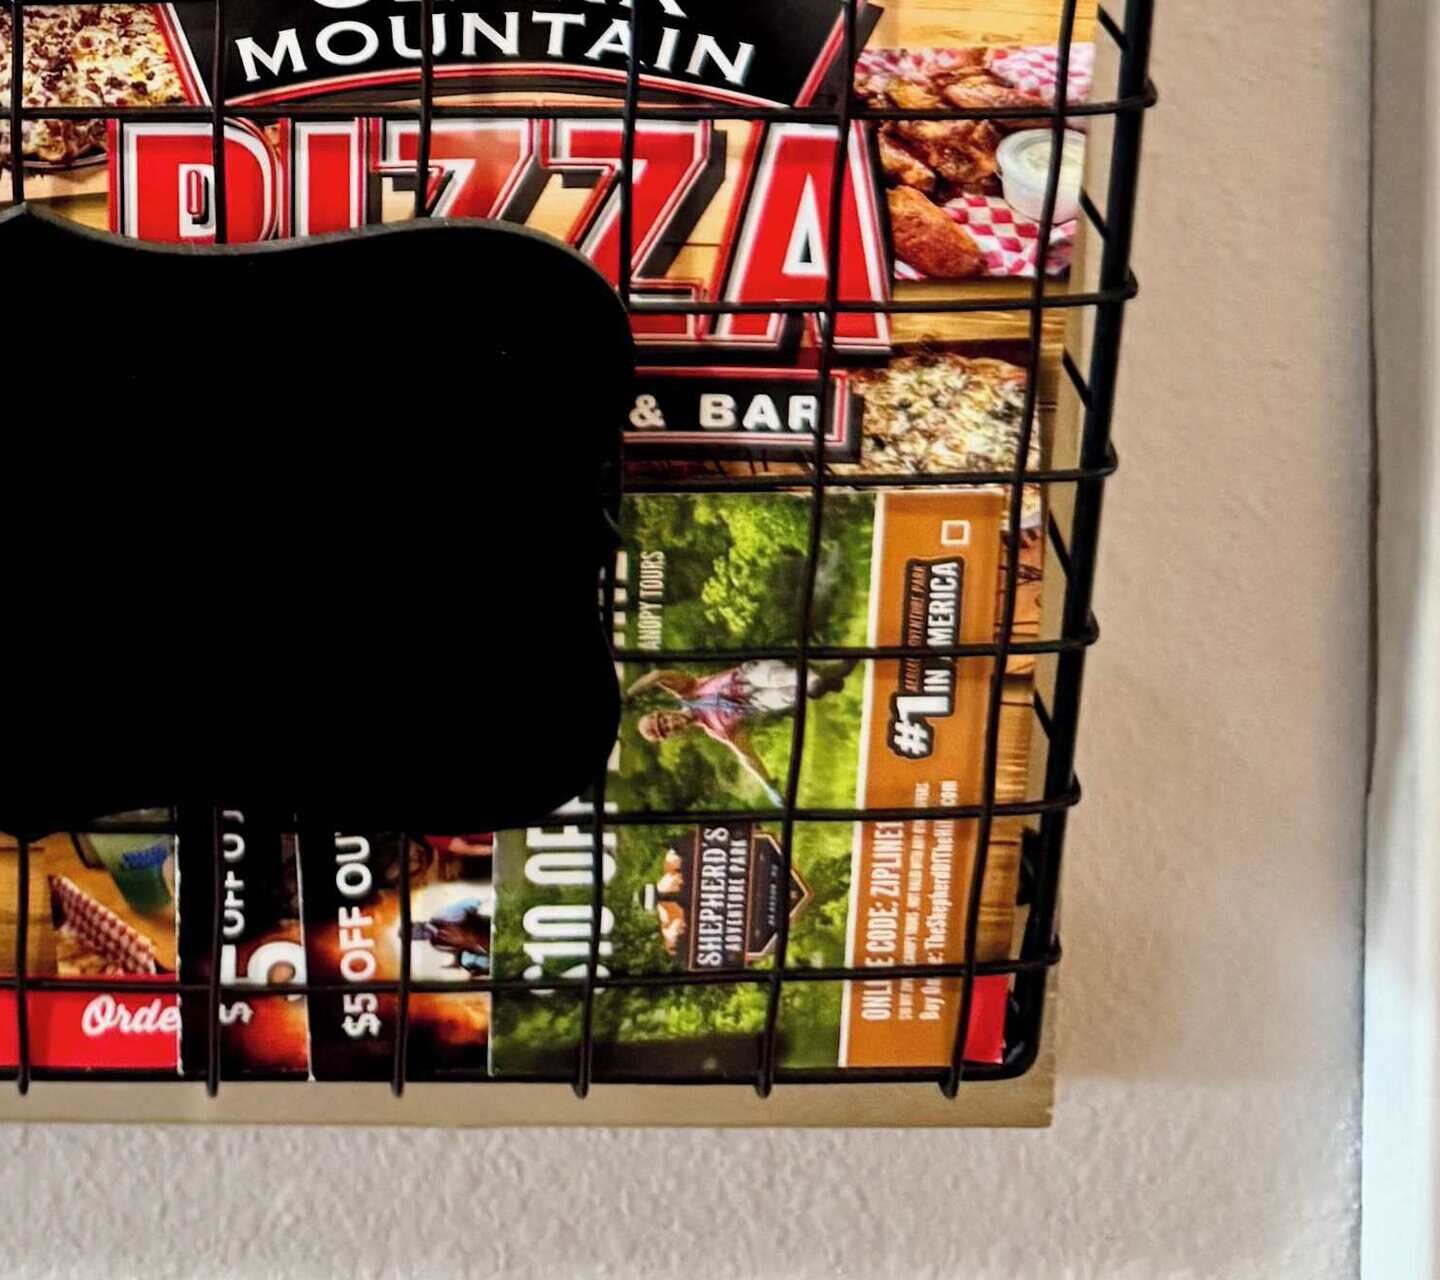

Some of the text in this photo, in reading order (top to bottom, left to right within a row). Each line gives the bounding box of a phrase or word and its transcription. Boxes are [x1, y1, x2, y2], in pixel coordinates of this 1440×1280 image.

[233, 10, 757, 87] MOUNTAIN
[628, 393, 819, 431] & BAR
[637, 550, 665, 651] ANOPY TOURS
[922, 561, 960, 693] IN MERICA
[892, 695, 952, 755] #1
[729, 838, 748, 874] PARK
[334, 831, 381, 1038] $5 OFF OU
[865, 901, 899, 953] CODE:
[861, 956, 895, 1021] ONLIE
